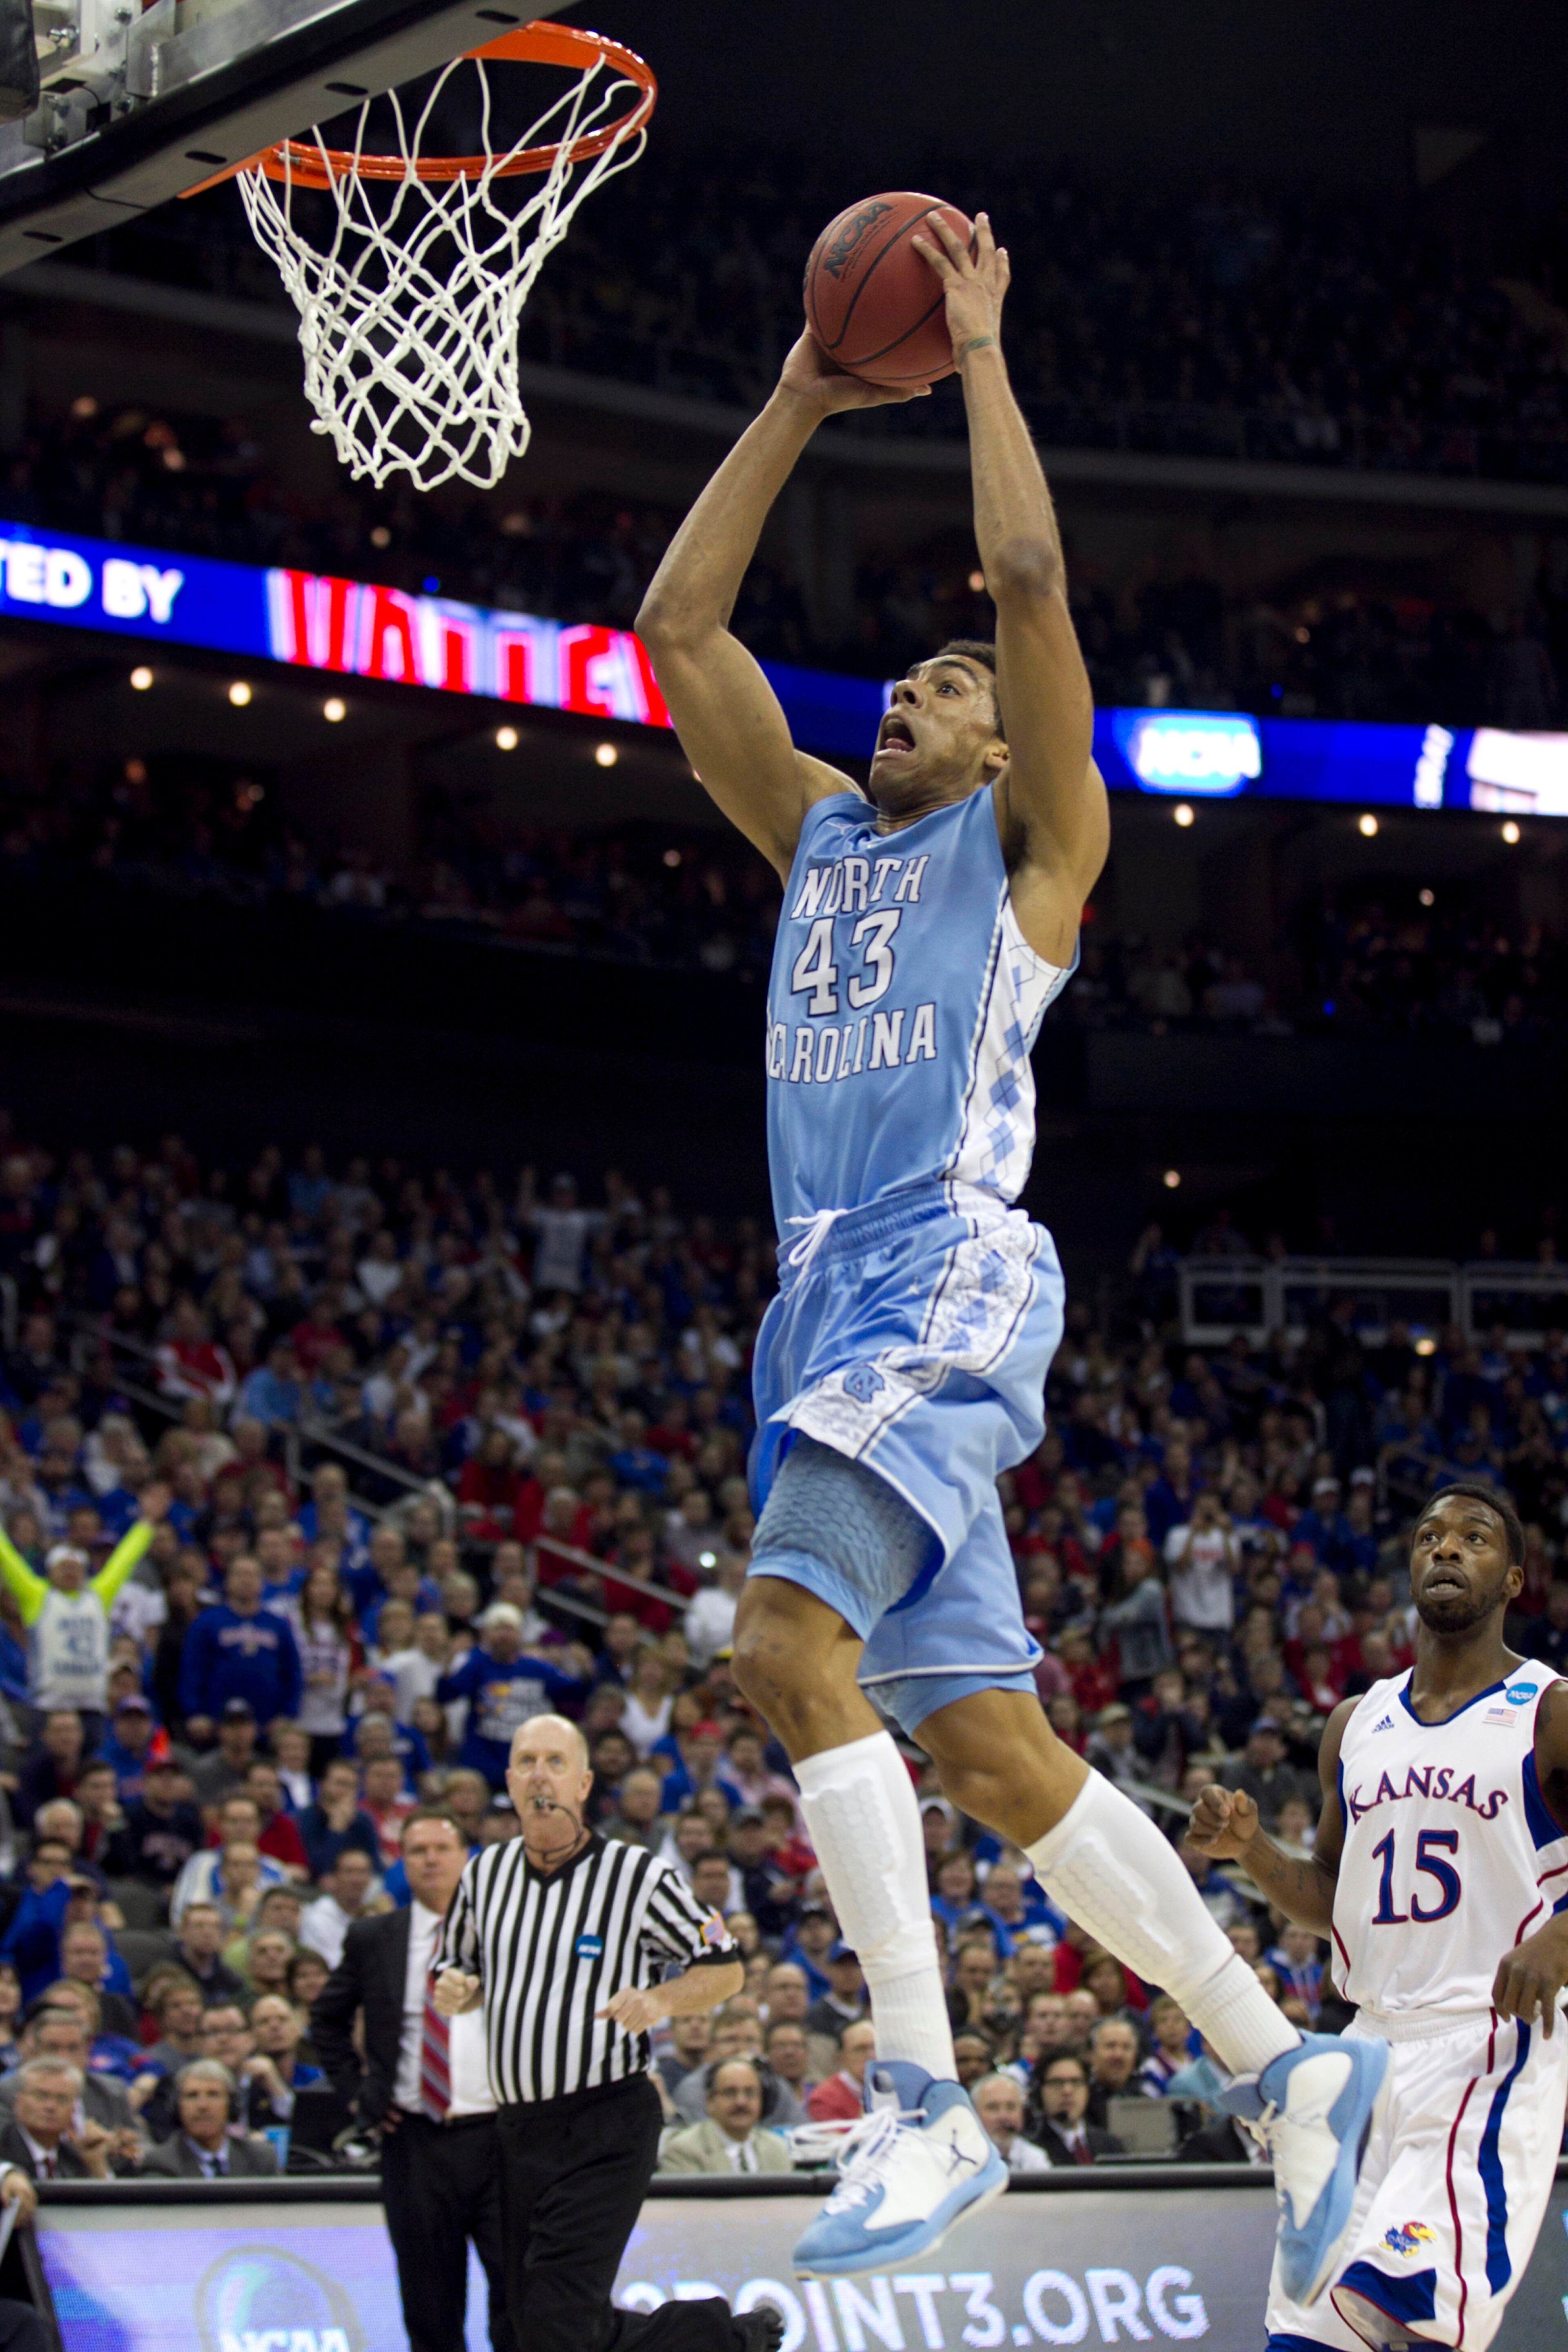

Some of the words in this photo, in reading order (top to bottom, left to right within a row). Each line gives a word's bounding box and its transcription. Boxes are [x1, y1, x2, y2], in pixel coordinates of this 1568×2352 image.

[824, 203, 893, 279] NCAA
[102, 558, 185, 624] BY
[789, 855, 931, 920] NORTH
[791, 907, 903, 1018] 43
[1508, 1690, 1535, 1701] NCAA
[1349, 1766, 1508, 1825] KANSAS
[1372, 1828, 1461, 1925] 15
